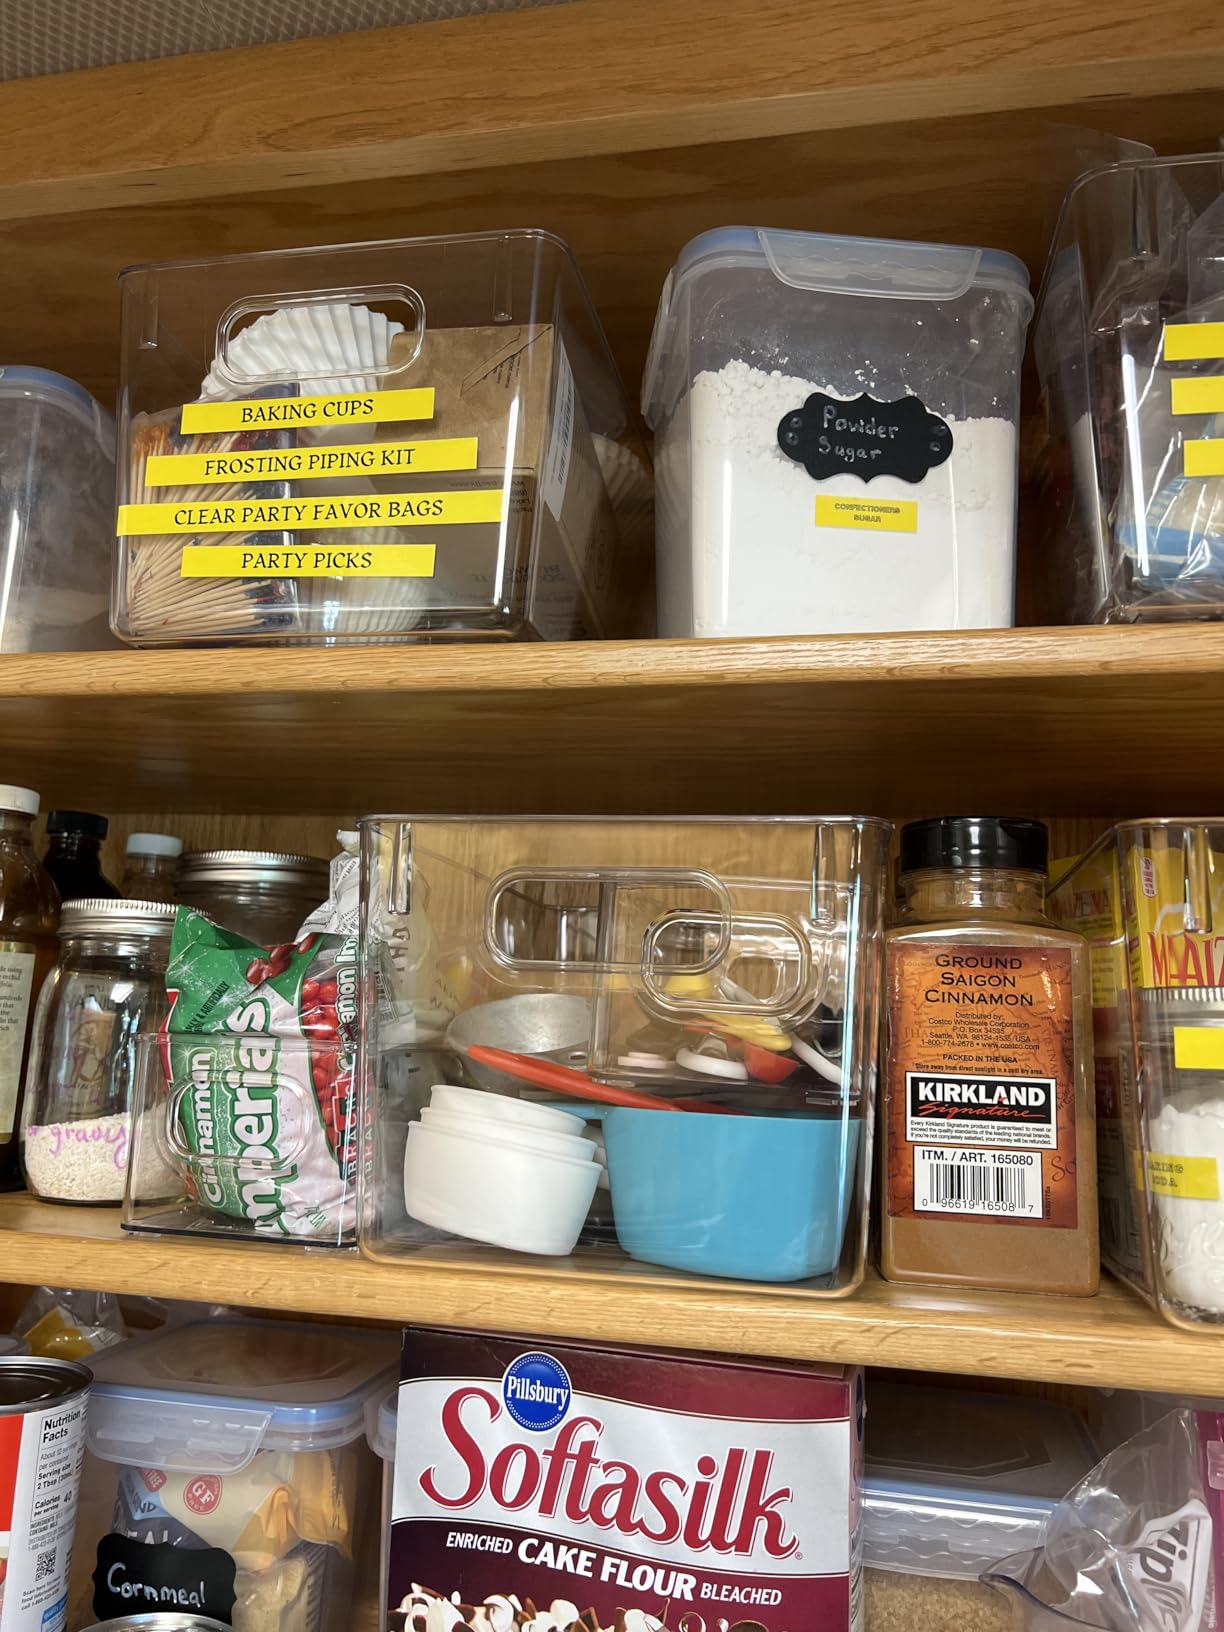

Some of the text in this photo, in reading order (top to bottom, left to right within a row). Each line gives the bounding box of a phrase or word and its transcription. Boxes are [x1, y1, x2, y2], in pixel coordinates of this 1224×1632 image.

[241, 399, 374, 423] BAKING CUPS
[823, 405, 899, 439] Powder
[818, 435, 882, 463] Sugar
[204, 448, 416, 476] FROSTING PIPING KIT
[174, 499, 444, 526] CLEAR PARTY FAVOR BAGS
[241, 551, 373, 569] PARTY PICKS
[935, 954, 1022, 970] GROUND
[941, 972, 1016, 988] SAIGON
[200, 980, 231, 1016] ARTIFICIALLY
[924, 989, 1033, 1006] CINNAMON
[928, 1017, 1030, 1029] Costco Wholesale Corporation
[955, 1011, 992, 1020] Distributed
[929, 1032, 953, 1040] Seattle,
[956, 1032, 969, 1040] WA
[1015, 1035, 1031, 1043] USA
[952, 1025, 1005, 1035] P.O. Box 34535
[981, 1042, 1040, 1051] www.costco.com
[942, 1053, 974, 1062] PACKED
[985, 1055, 1001, 1063] THE
[1001, 1056, 1018, 1064] USA
[974, 1065, 996, 1073] sunlight
[918, 1081, 1046, 1106] KIRKLAND
[918, 1101, 1046, 1120] Signature
[190, 1054, 223, 1204] Cinnamon
[946, 1122, 969, 1130] Signature
[922, 1150, 1034, 1165] ITM. / ART. 165080
[922, 1198, 1034, 1213] 0 96619 16508 7
[507, 1376, 570, 1411] Pillsbury
[44, 1410, 81, 1430] Nutrition
[43, 1427, 68, 1443] Facts
[38, 1467, 61, 1480] Serving
[418, 1386, 799, 1561] Softasilk
[37, 1482, 42, 1490] 2
[43, 1478, 58, 1488] Tbsp
[192, 1481, 215, 1505] GF
[35, 1495, 60, 1509] Calories
[446, 1532, 783, 1606] ENRICHED CAKE FLOUR BLEACHED
[107, 1562, 205, 1608] Cornmeal
